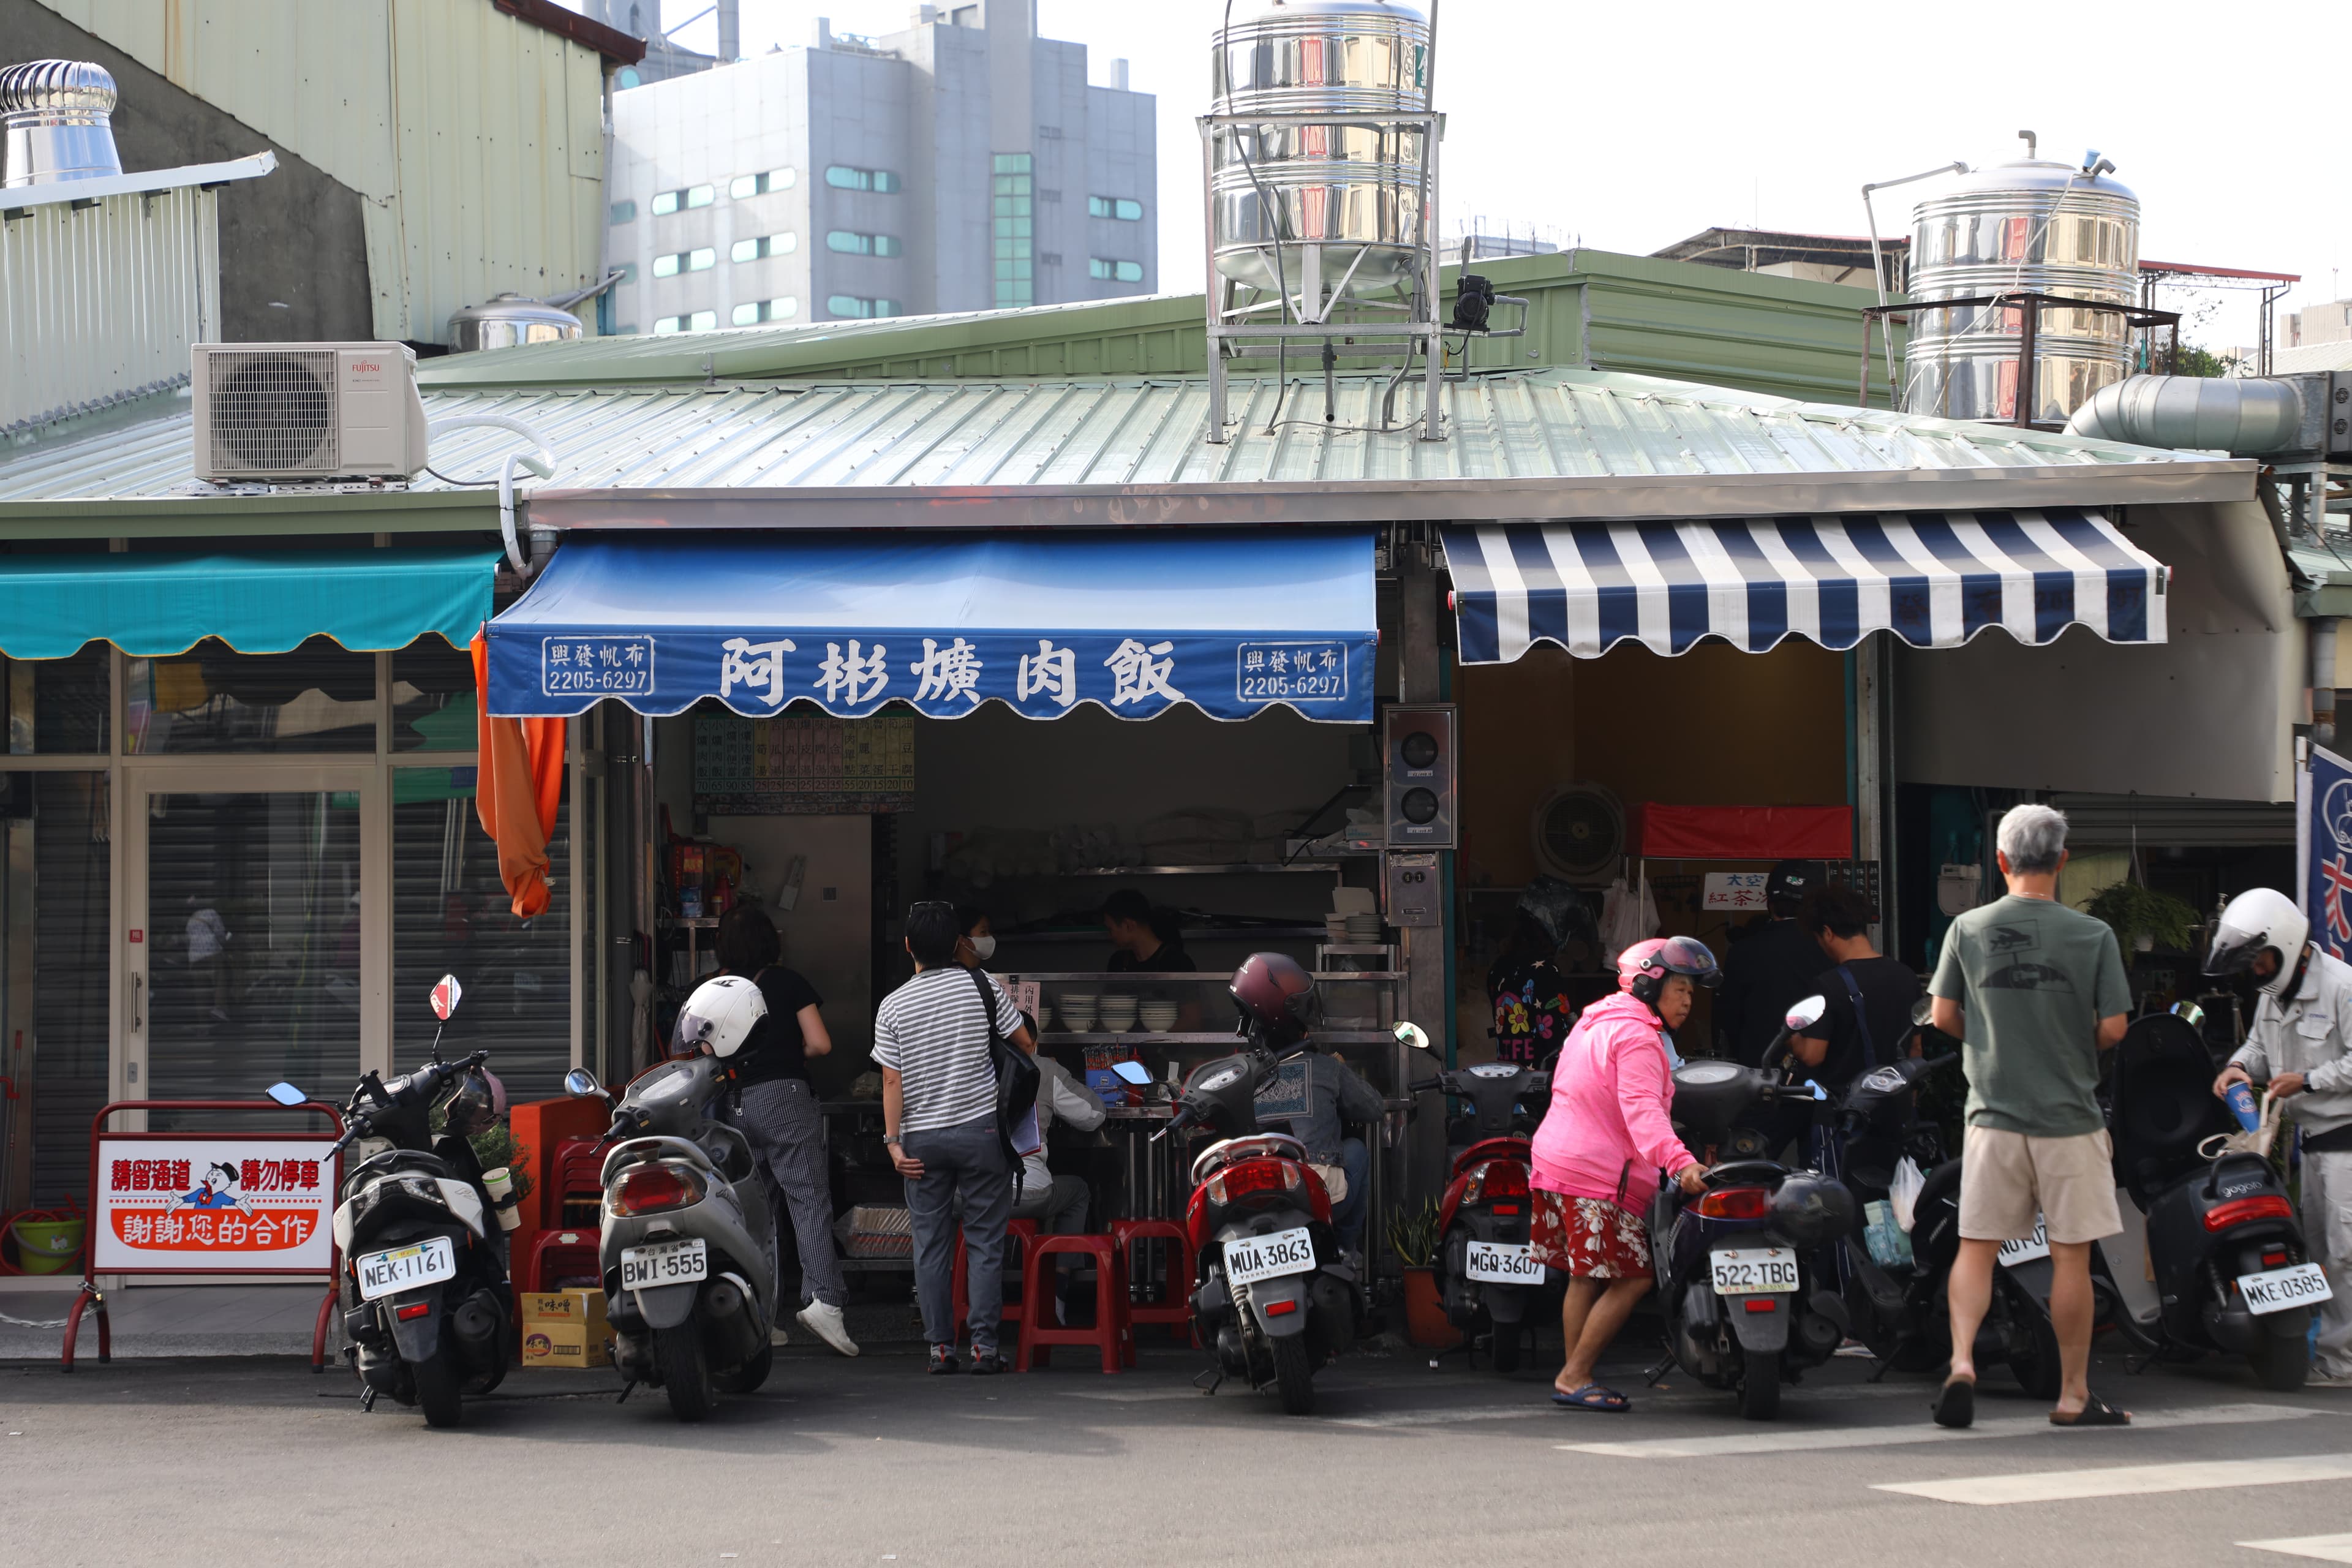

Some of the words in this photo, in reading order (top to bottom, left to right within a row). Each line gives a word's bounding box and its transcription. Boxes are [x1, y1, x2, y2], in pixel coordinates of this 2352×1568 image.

[352, 361, 380, 373] FUJITSU
[550, 644, 645, 668] 興發帆布
[1245, 649, 1338, 673] 興發帆布
[720, 637, 1186, 707] 阿彬爌肉飯
[549, 671, 646, 689] 2205-6297
[1245, 676, 1340, 695] 2205-6297
[697, 782, 708, 790] 70
[712, 782, 722, 790] 65
[726, 782, 737, 790] 90
[741, 782, 752, 790] 85
[755, 782, 766, 790] 25
[770, 782, 781, 790] 25
[785, 782, 796, 790] 25
[801, 780, 812, 789] 25
[815, 780, 826, 789] 25
[829, 780, 840, 789] 35
[844, 780, 855, 789] 55
[859, 780, 870, 789] 20
[873, 780, 883, 789] 15
[888, 780, 898, 789] 20
[903, 780, 913, 789] 10
[111, 1159, 191, 1191] 請留通道
[241, 1159, 320, 1191] 請勿停車
[2224, 1182, 2263, 1197] gogoro
[123, 1214, 309, 1245] 謝謝您的合作
[647, 1245, 678, 1256] 台灣省
[1230, 1239, 1310, 1275] MUA-3863
[365, 1250, 445, 1287] NEK-1161
[624, 1253, 705, 1283] BWI-555
[1715, 1263, 1796, 1286] 522-TBG
[2245, 1273, 2325, 1305] MKE-0385
[545, 1298, 571, 1312] 味噌
